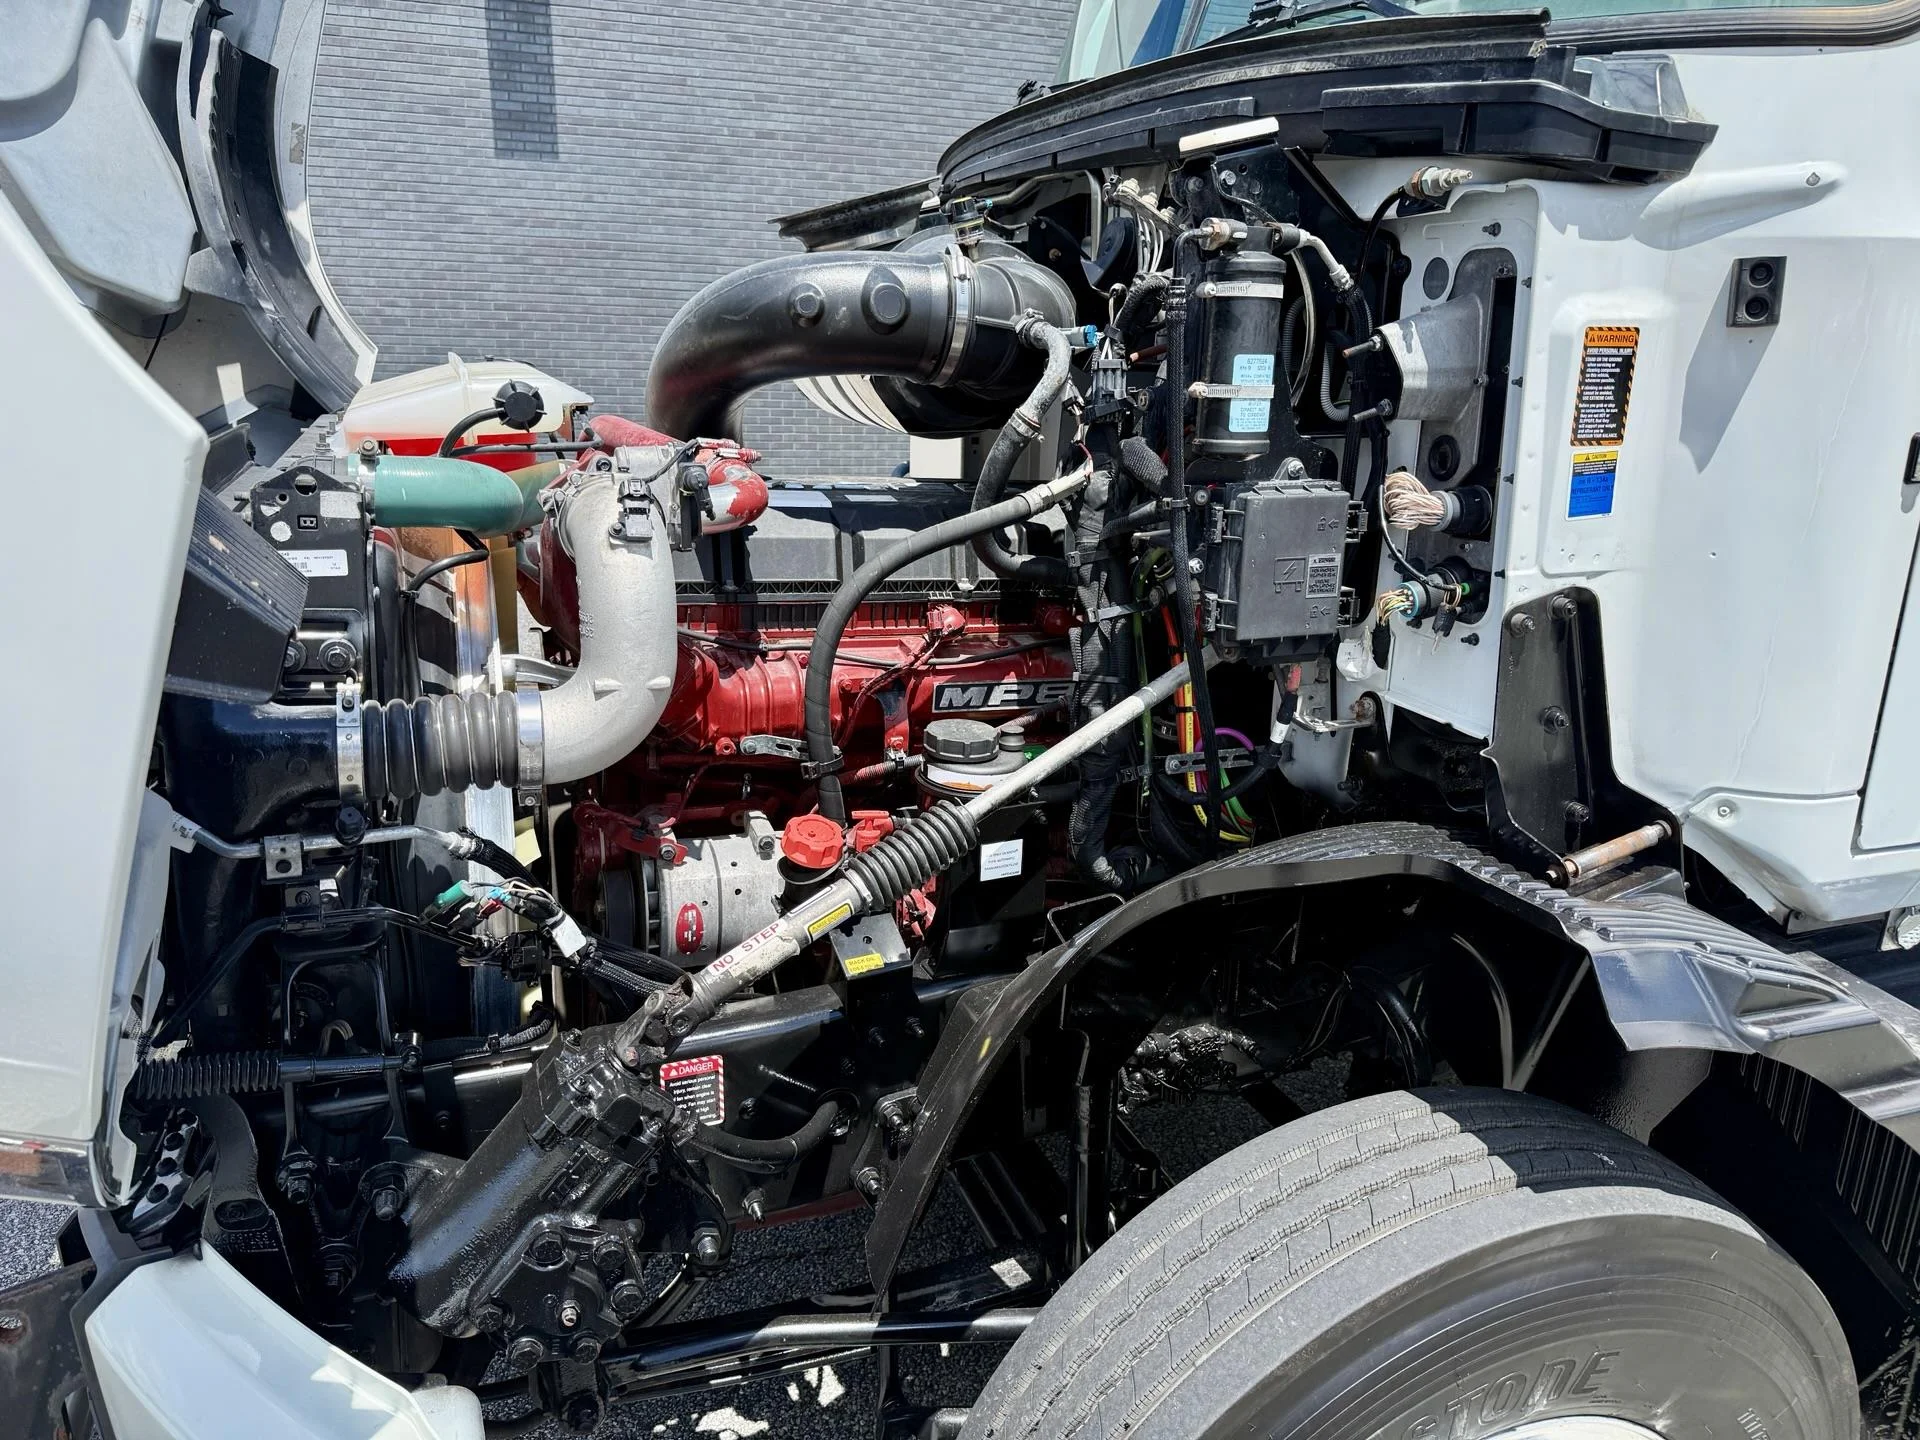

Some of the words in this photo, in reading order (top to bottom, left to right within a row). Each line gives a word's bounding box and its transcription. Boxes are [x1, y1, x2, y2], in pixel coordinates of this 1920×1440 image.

[1597, 334, 1634, 343] WARNING
[713, 954, 734, 972] NO
[742, 923, 780, 952] STEP
[679, 1062, 714, 1075] DANGER
[698, 1075, 716, 1083] personal
